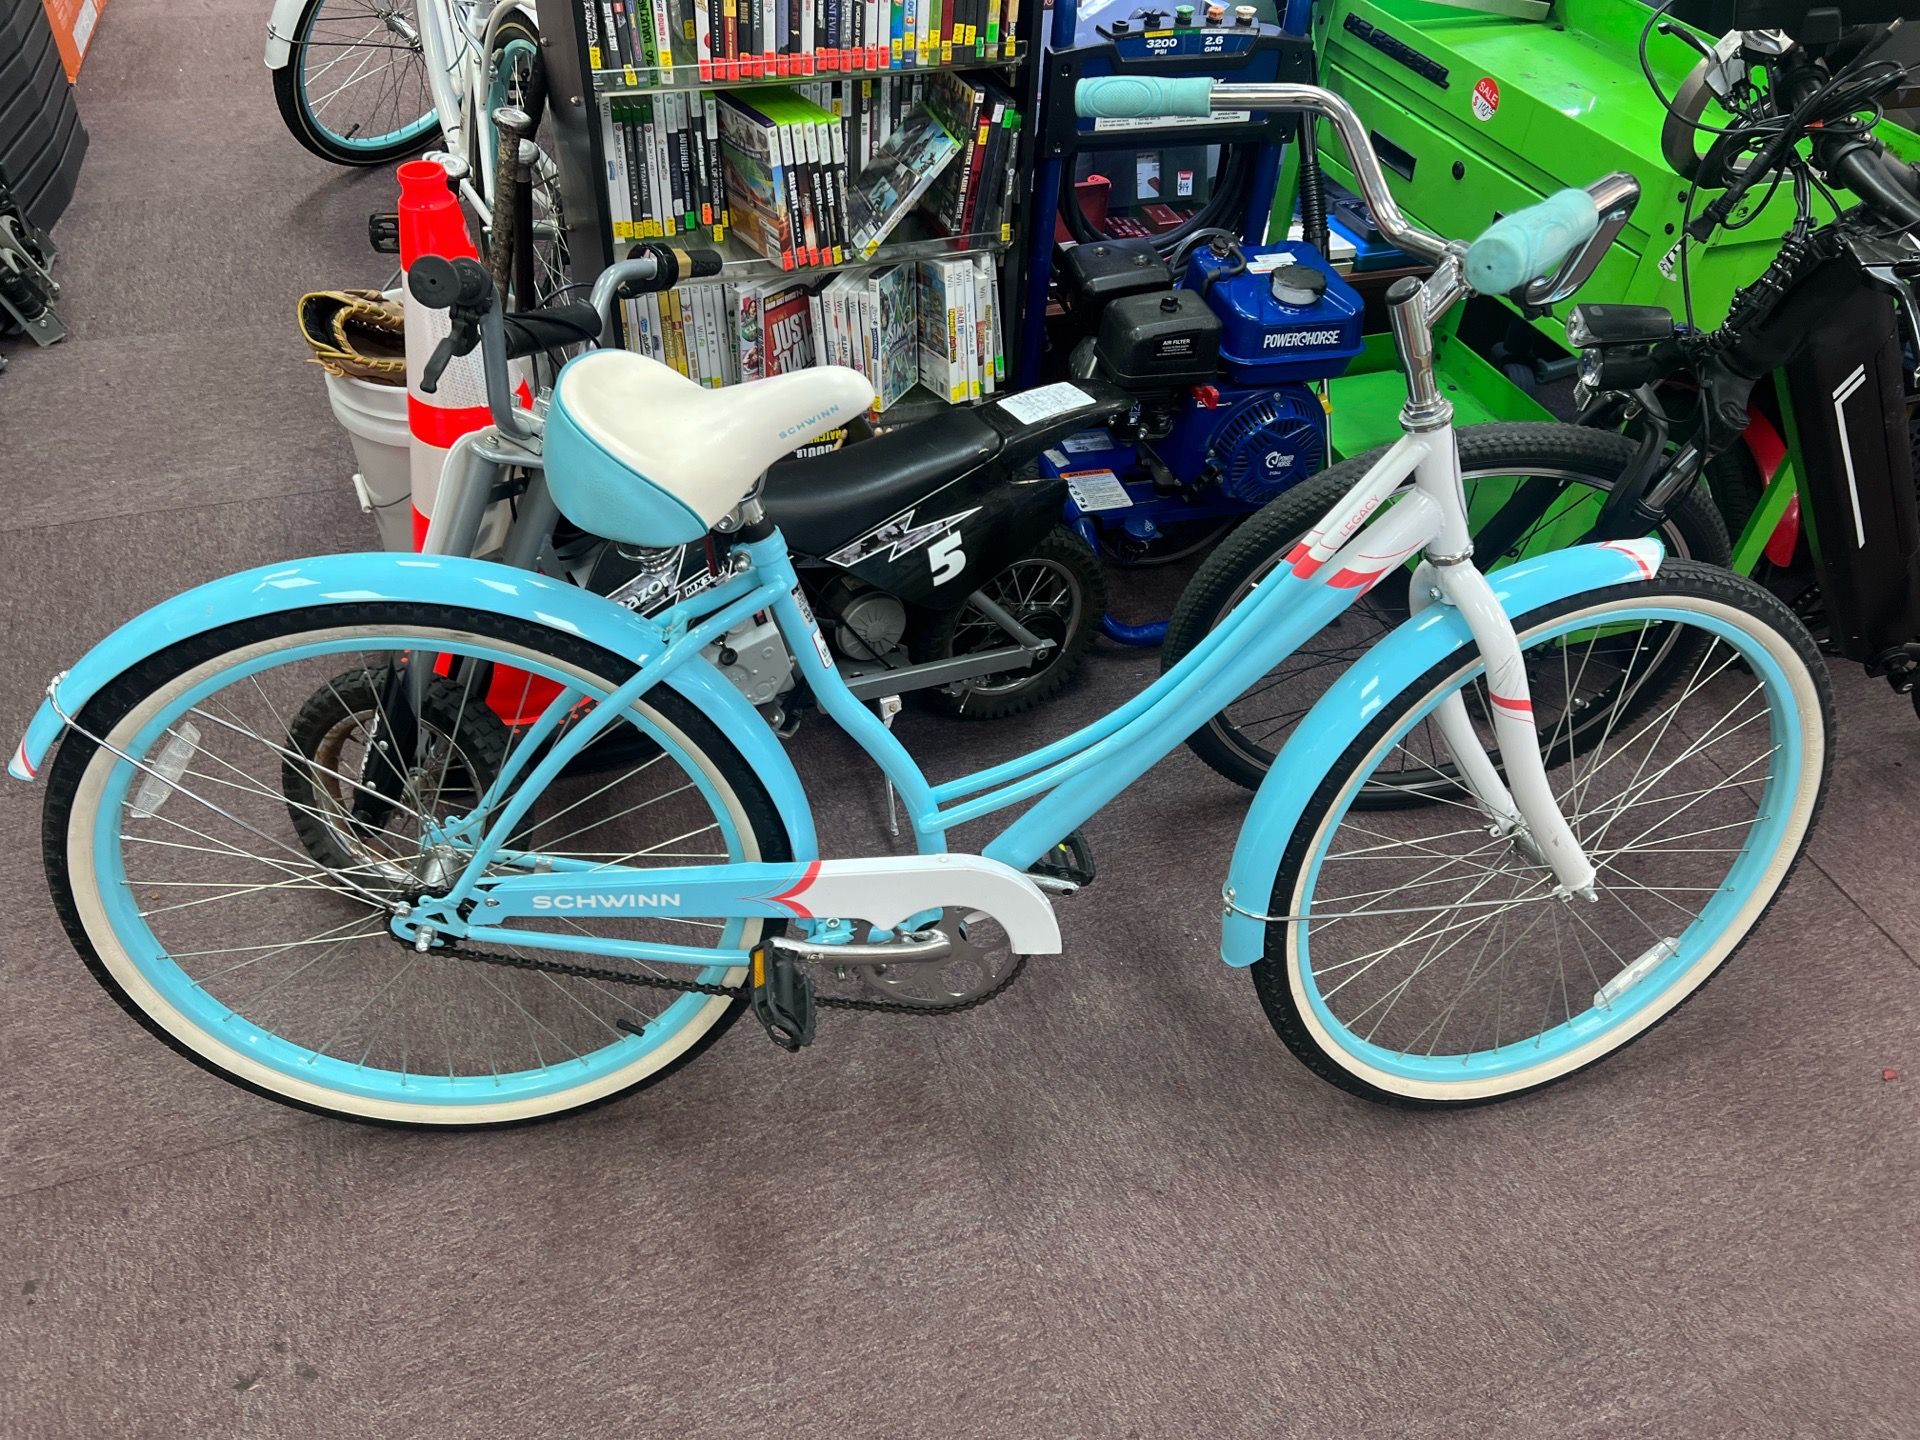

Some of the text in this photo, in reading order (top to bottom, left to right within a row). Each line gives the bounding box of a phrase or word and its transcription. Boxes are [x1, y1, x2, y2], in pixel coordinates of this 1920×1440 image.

[740, 2, 748, 24] NOIRE
[828, 16, 836, 35] EVIL
[1146, 38, 1177, 49] 3200
[1205, 36, 1223, 45] 2.6
[1478, 81, 1498, 105] SALE
[602, 102, 610, 117] Wii
[679, 133, 689, 168] BATTLEFIELD
[964, 139, 974, 165] JUSTICE
[640, 163, 648, 201] TITANFALL
[711, 168, 718, 179] OF
[959, 167, 970, 193] LEAGUE
[642, 334, 651, 355] studio
[772, 310, 807, 357] JUST
[1263, 330, 1340, 348] POWERHORSE
[779, 333, 815, 373] DAN
[779, 403, 839, 439] SCHWINN
[1278, 454, 1295, 462] POWER
[1340, 494, 1380, 537] LEGACY
[928, 530, 966, 587] 5
[616, 572, 672, 610] azor
[532, 893, 680, 909] SCHWINN
